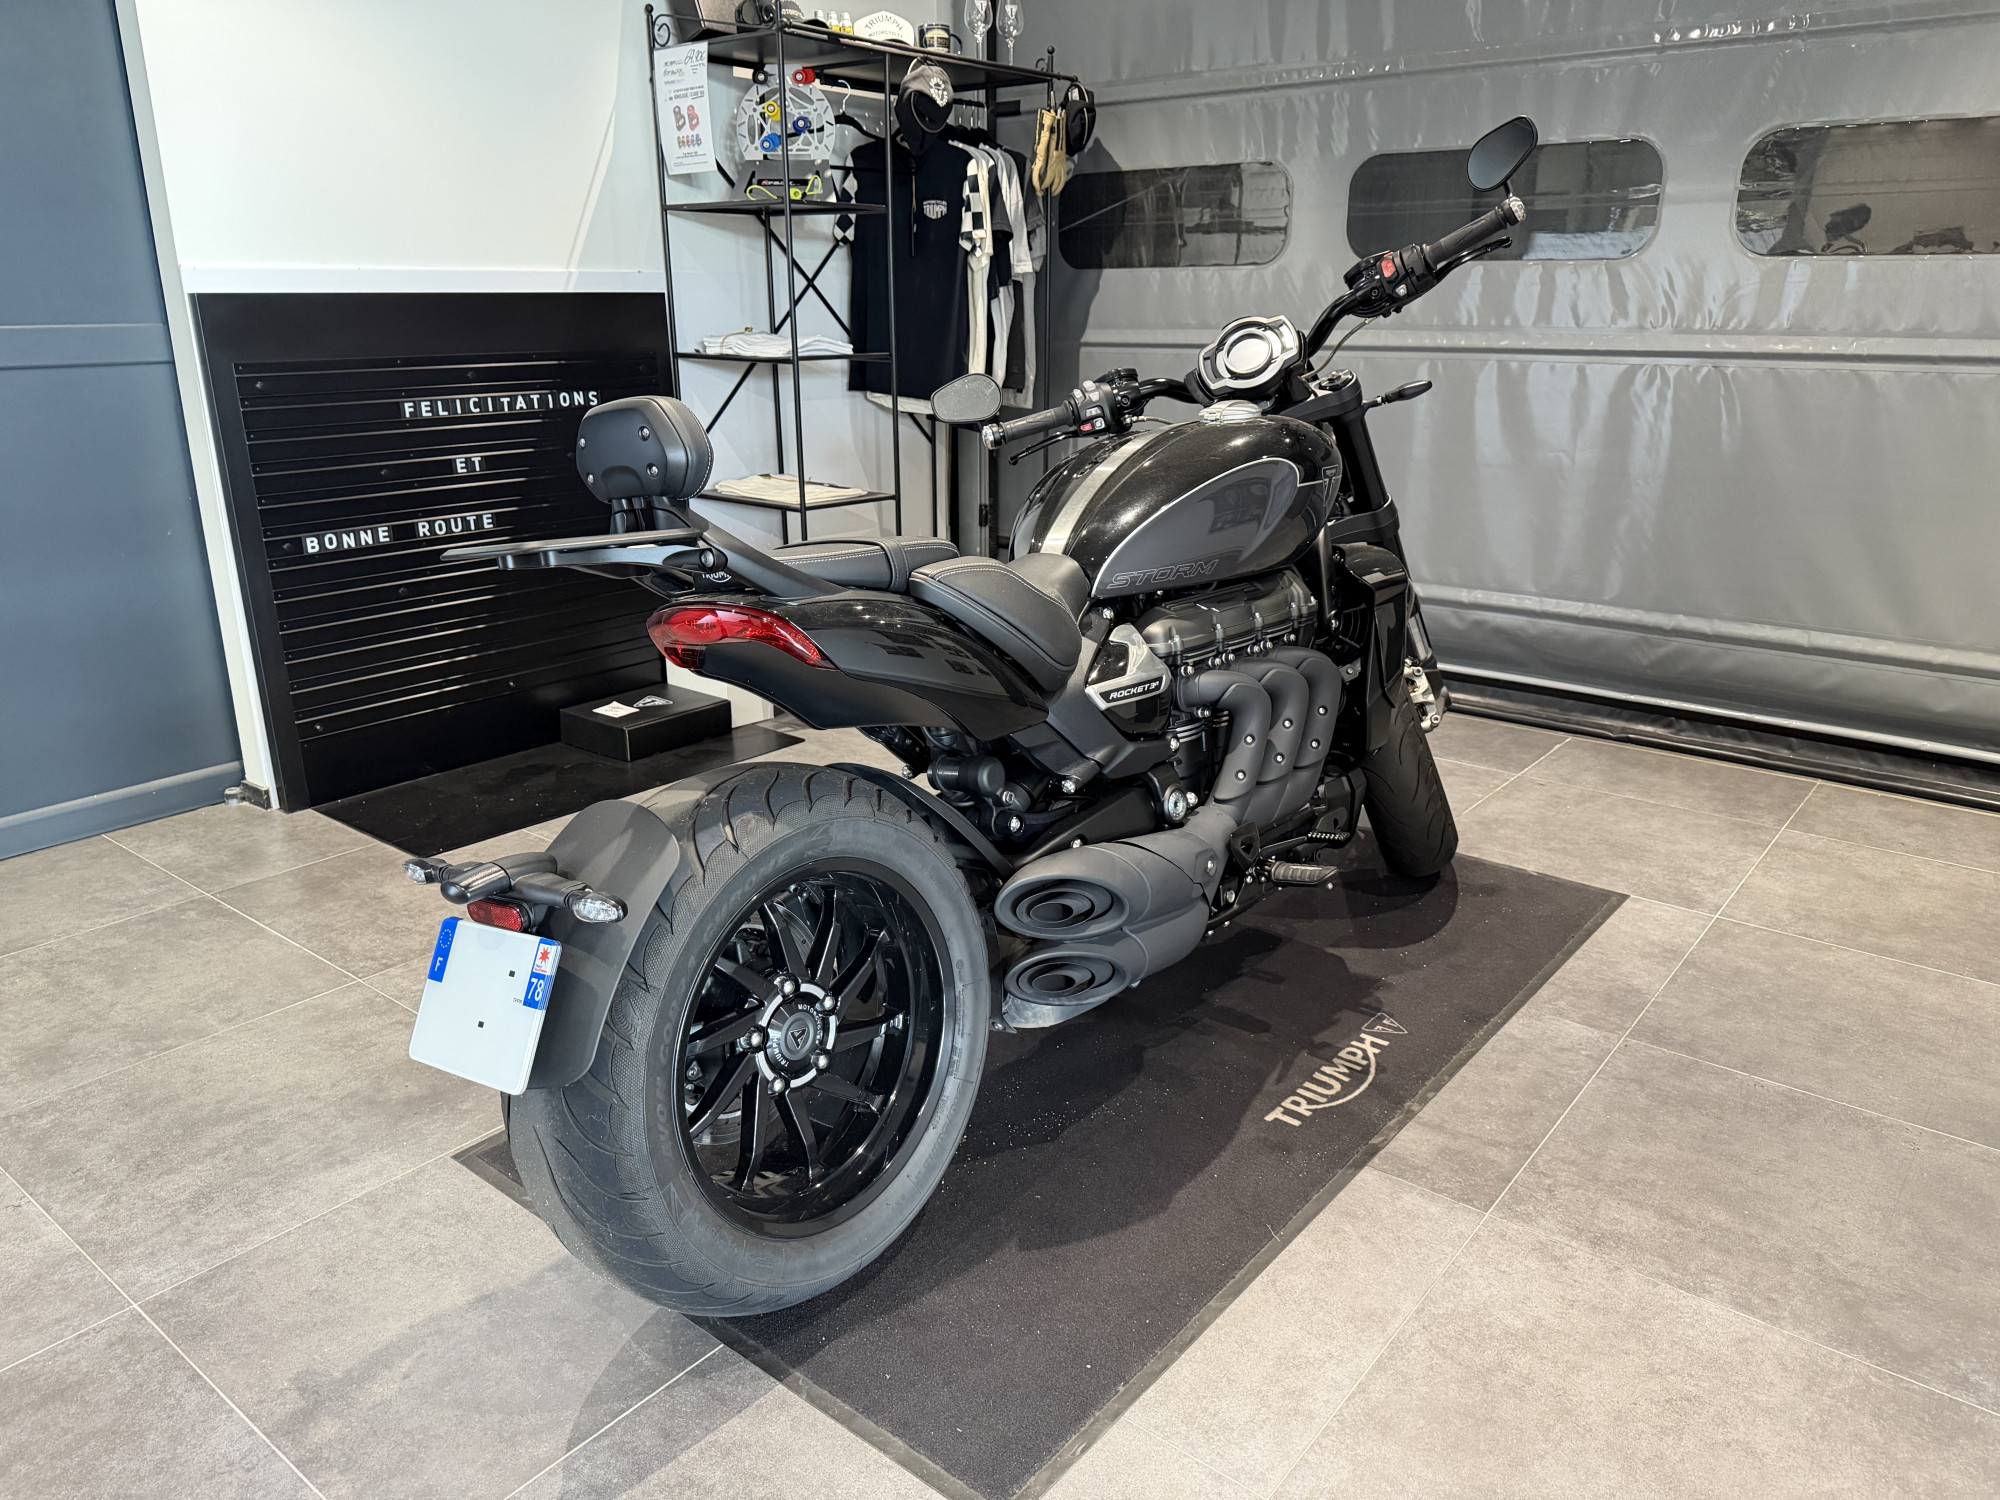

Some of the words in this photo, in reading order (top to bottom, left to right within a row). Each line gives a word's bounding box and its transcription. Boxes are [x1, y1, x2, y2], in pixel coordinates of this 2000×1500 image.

[864, 14, 904, 32] TRIUMPH
[404, 390, 599, 419] FELICITATIONS
[455, 456, 483, 474] ET
[305, 526, 391, 554] BONNE
[417, 513, 495, 538] ROUTE
[1106, 559, 1219, 590] STORM
[434, 956, 444, 972] F
[527, 976, 544, 1002] 78
[771, 1036, 790, 1068] TRIUMPH
[1263, 1032, 1391, 1127] TRIUMPH
